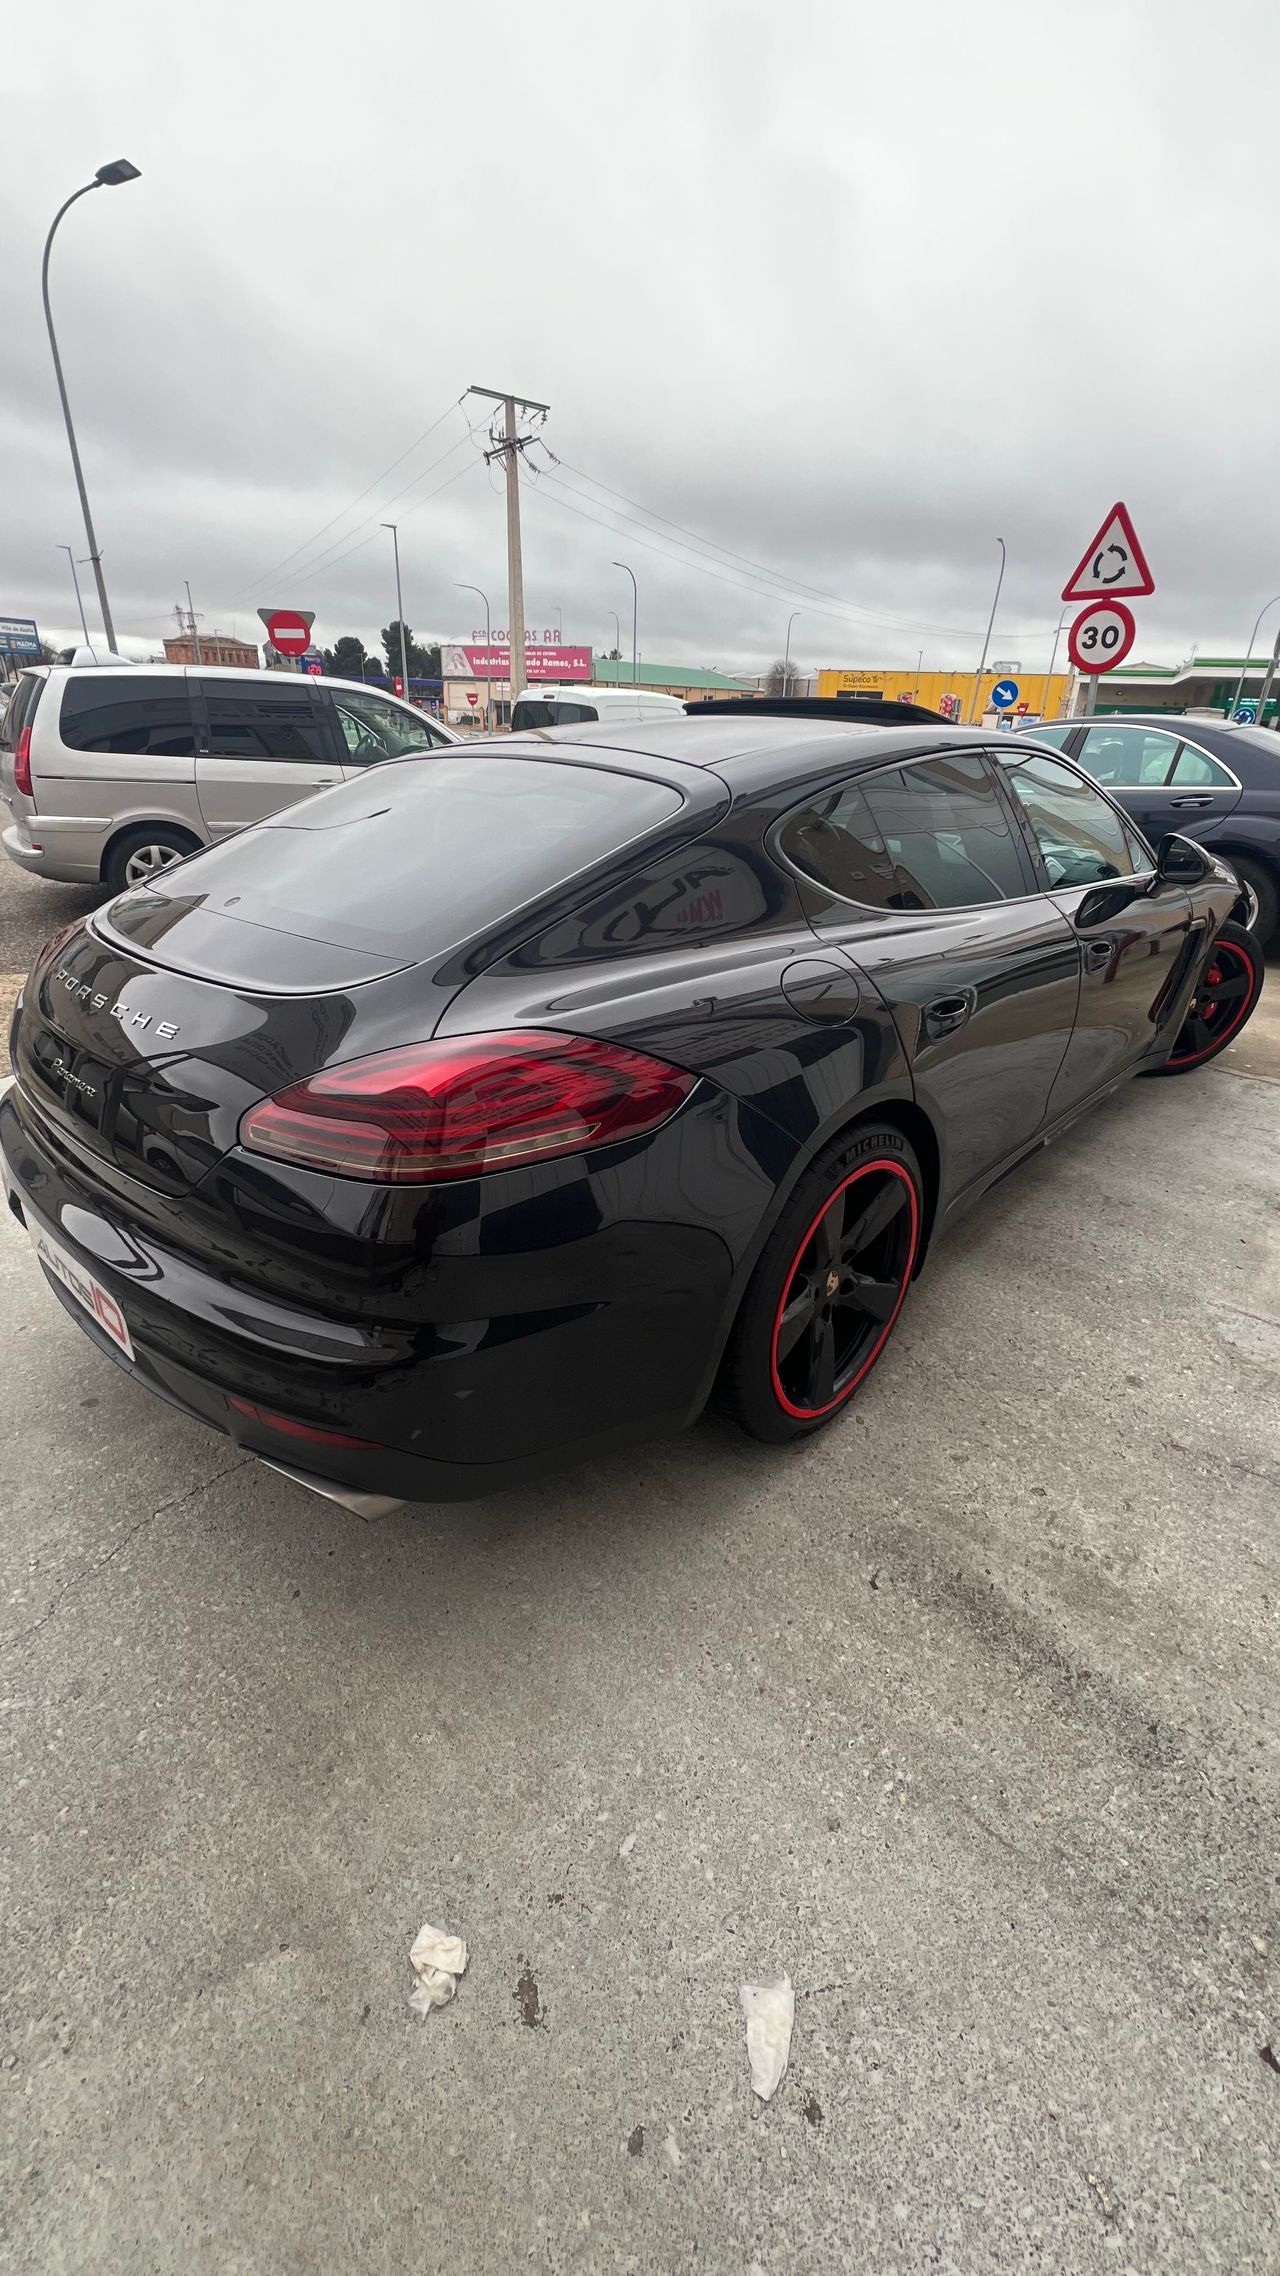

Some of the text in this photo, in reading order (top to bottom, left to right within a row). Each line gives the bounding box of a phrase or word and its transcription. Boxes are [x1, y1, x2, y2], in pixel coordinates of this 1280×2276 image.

[491, 629, 537, 641] COCAS
[543, 629, 561, 642] AR
[1081, 625, 1119, 649] 30
[473, 657, 510, 667] Industrias
[543, 659, 571, 669] Ramos,
[573, 659, 587, 668] S.L.
[843, 674, 871, 684] Supeco
[56, 969, 180, 1040] PORSCHE
[51, 1058, 97, 1097] Panamera
[845, 1134, 905, 1161] MICHELIN
